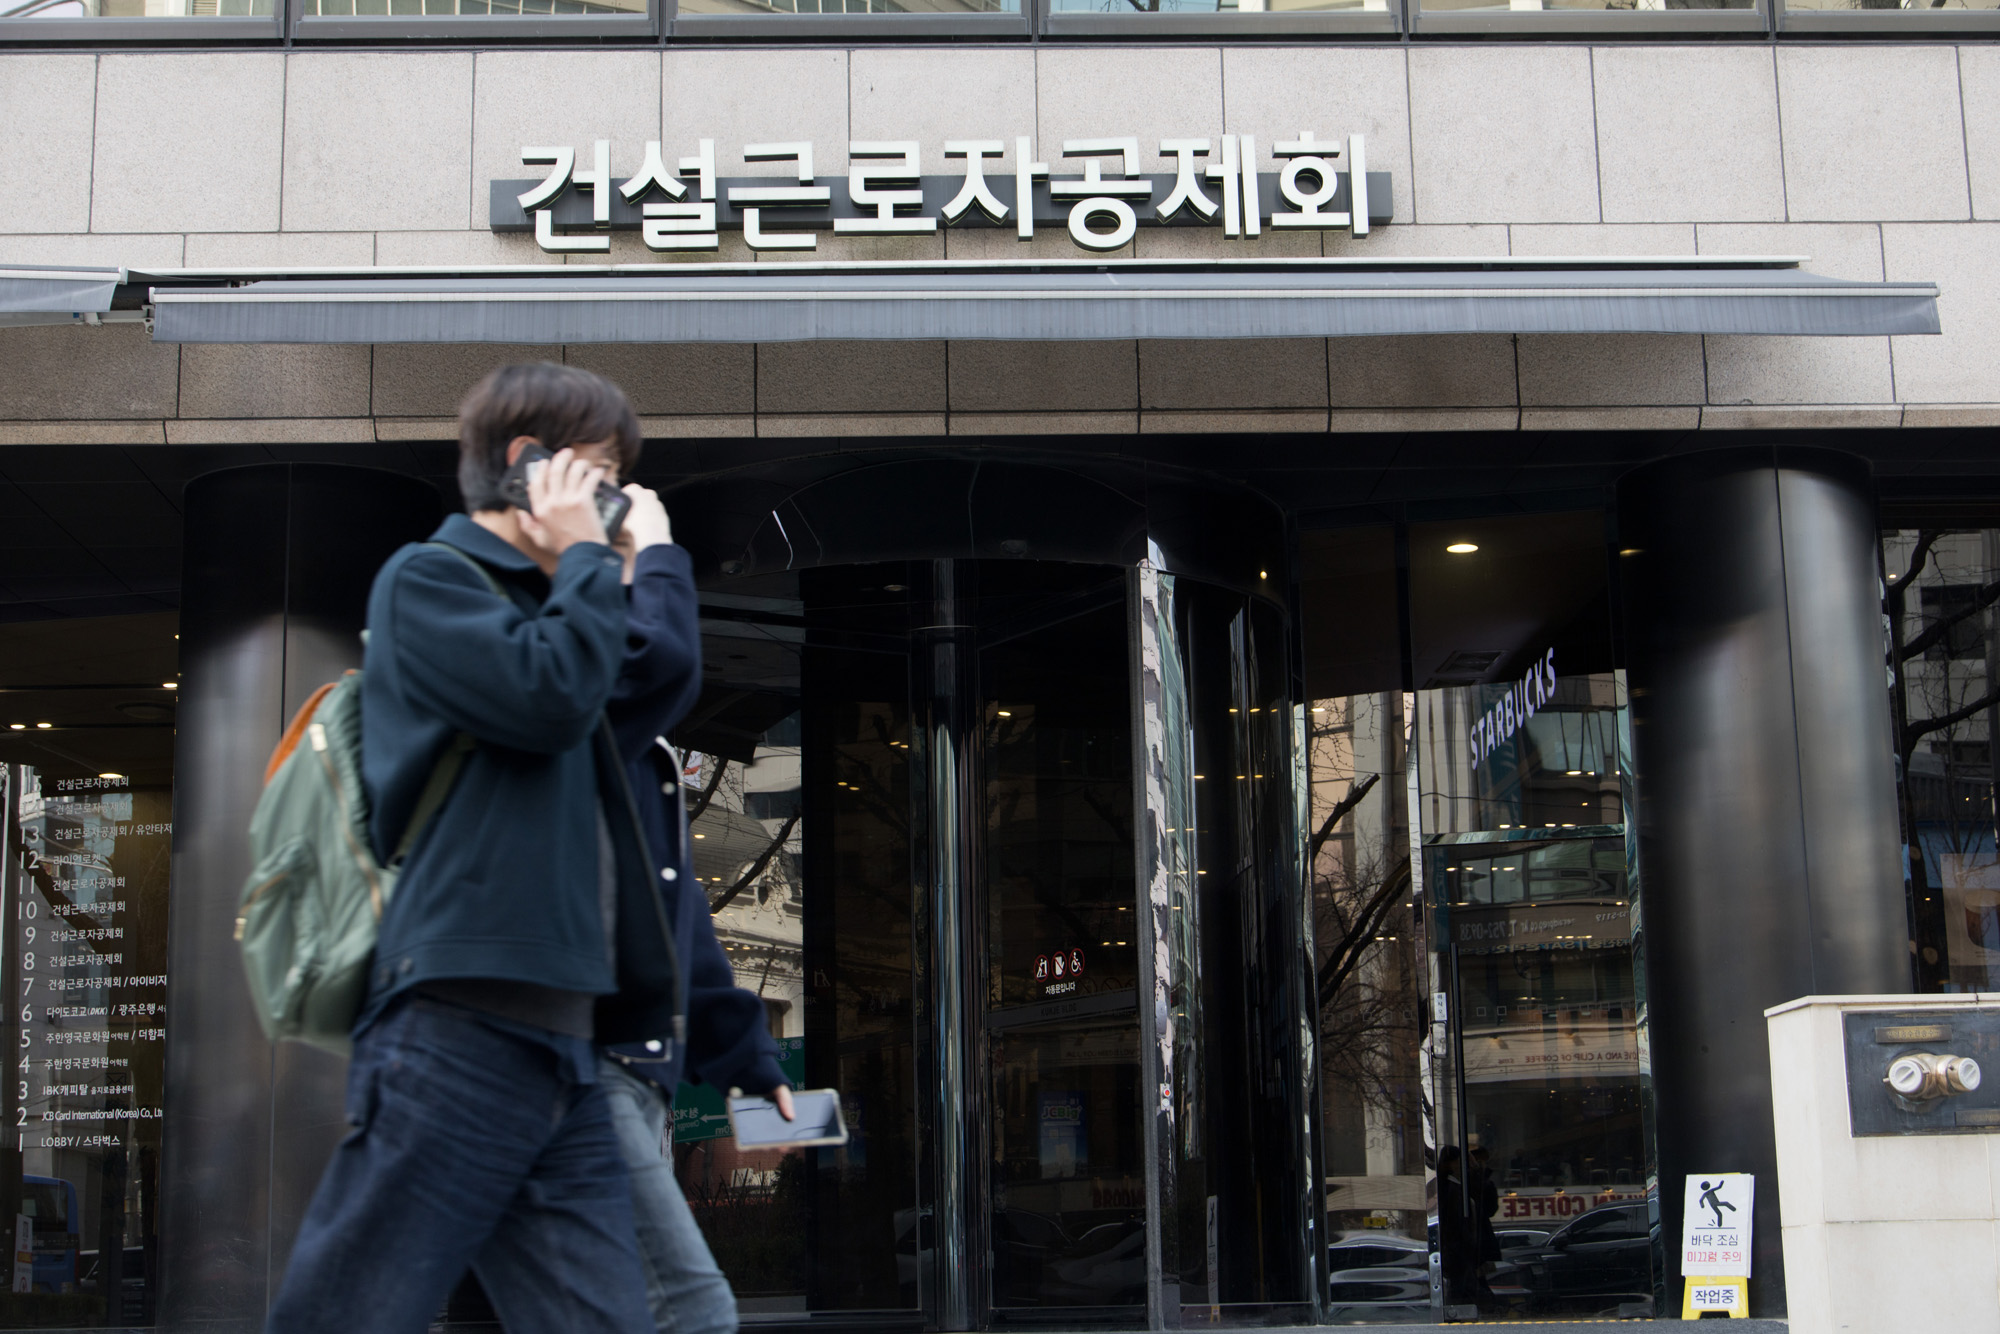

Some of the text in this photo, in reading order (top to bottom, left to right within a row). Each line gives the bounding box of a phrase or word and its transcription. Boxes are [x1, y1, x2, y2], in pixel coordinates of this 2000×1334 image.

[517, 131, 1369, 255] 건설근로자공제회
[1470, 646, 1556, 770] STARBUCKS
[56, 776, 129, 791] 건설근로자공제회
[55, 801, 128, 816] 건설근로자공제회
[20, 826, 40, 844] 13
[54, 825, 127, 840] 건설근로자공제회
[20, 851, 40, 869] 12
[19, 876, 125, 894] 11 건설근로자공제회
[18, 901, 126, 920] 10 건설근로자공제회
[25, 927, 124, 945] 9 건설근로자공제회
[23, 952, 122, 970] 8 건설근로자공제회
[23, 978, 34, 996] 7
[48, 976, 121, 991] 건설근로자공제회
[1045, 981, 1076, 996] 자동문입니다
[21, 1003, 33, 1022] 6
[118, 1003, 156, 1016] 광주은행
[20, 1029, 31, 1048] 5
[19, 1054, 31, 1074] 4
[18, 1080, 28, 1100] 3
[43, 1083, 88, 1096] IBK캐피탈
[16, 1107, 28, 1126] 2
[54, 1110, 70, 1121] Card
[71, 1109, 114, 1120] International
[115, 1108, 139, 1120] (Korea)
[18, 1133, 23, 1152] 1
[41, 1136, 74, 1147] LOBBY
[82, 1135, 120, 1147] 스타벅스
[1691, 1234, 1739, 1246] 바닥 조심
[1687, 1251, 1742, 1263] 미끄럼 주의
[1695, 1289, 1735, 1305] 작업중
